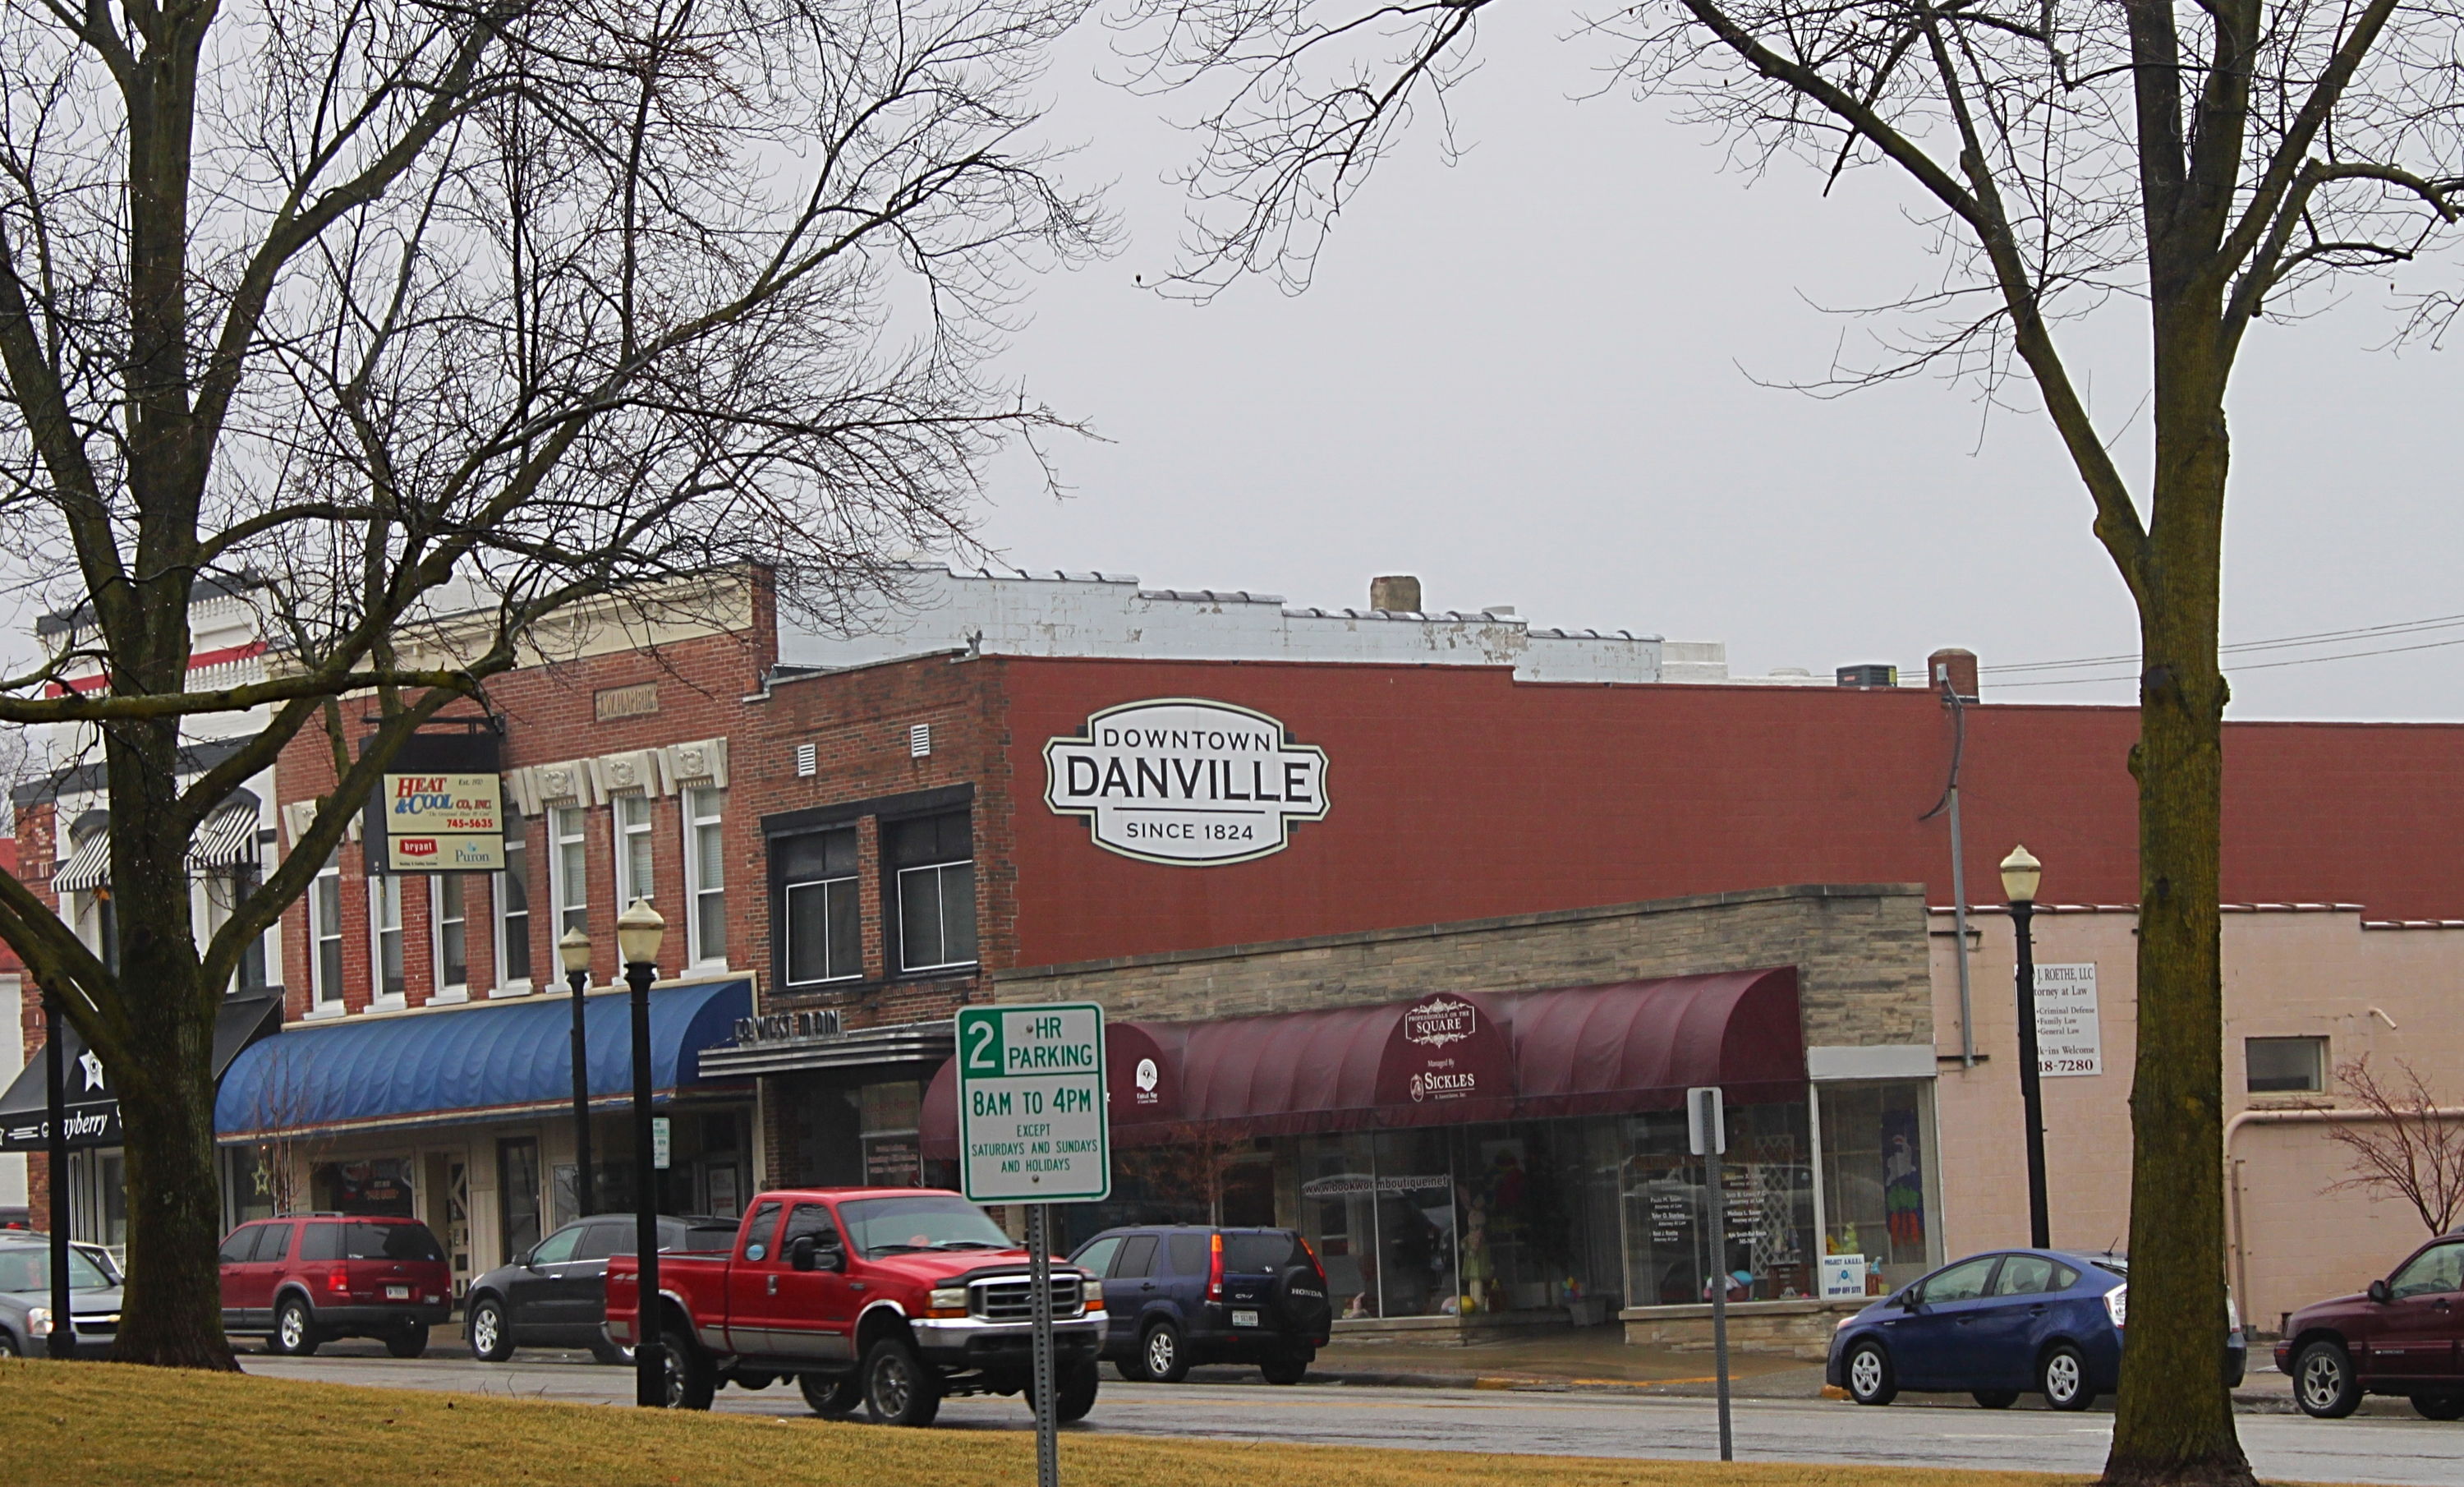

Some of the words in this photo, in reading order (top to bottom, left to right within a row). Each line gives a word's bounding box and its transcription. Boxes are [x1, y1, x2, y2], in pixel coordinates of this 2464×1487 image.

[1103, 729, 1271, 752] DOWNTOWN
[1066, 755, 1313, 803] DANVILLE
[395, 776, 448, 799] HEAT
[446, 818, 493, 828] 745-5635
[1126, 822, 1195, 840] SINCE
[1204, 824, 1253, 840] 1824
[404, 841, 433, 853] bryant
[455, 849, 490, 863] Puron
[2037, 969, 2043, 985] J.
[2079, 968, 2094, 980] LLC
[2071, 986, 2088, 996] Law
[1036, 1016, 1062, 1039] HR
[1416, 1018, 1462, 1034] SQUARE
[968, 1020, 995, 1069] 2
[2062, 1045, 2095, 1054] Welcome
[1009, 1043, 1092, 1070] PARKING
[2038, 1059, 2094, 1072] 18-7280
[973, 1090, 1012, 1117] 8AM
[1023, 1091, 1043, 1115] TO
[1053, 1087, 1092, 1113] 4PM
[1017, 1123, 1050, 1138] EXCEPT
[972, 1142, 1025, 1157] SATURDAYS
[1031, 1141, 1050, 1154] AND
[1056, 1139, 1097, 1153] SUNDAYS
[1001, 1160, 1020, 1173] AND
[1026, 1158, 1070, 1172] HOLIDAYS
[1291, 1287, 1323, 1298] HONDA
[1841, 1287, 1850, 1295] OFF
[1851, 1286, 1861, 1294] SITE
